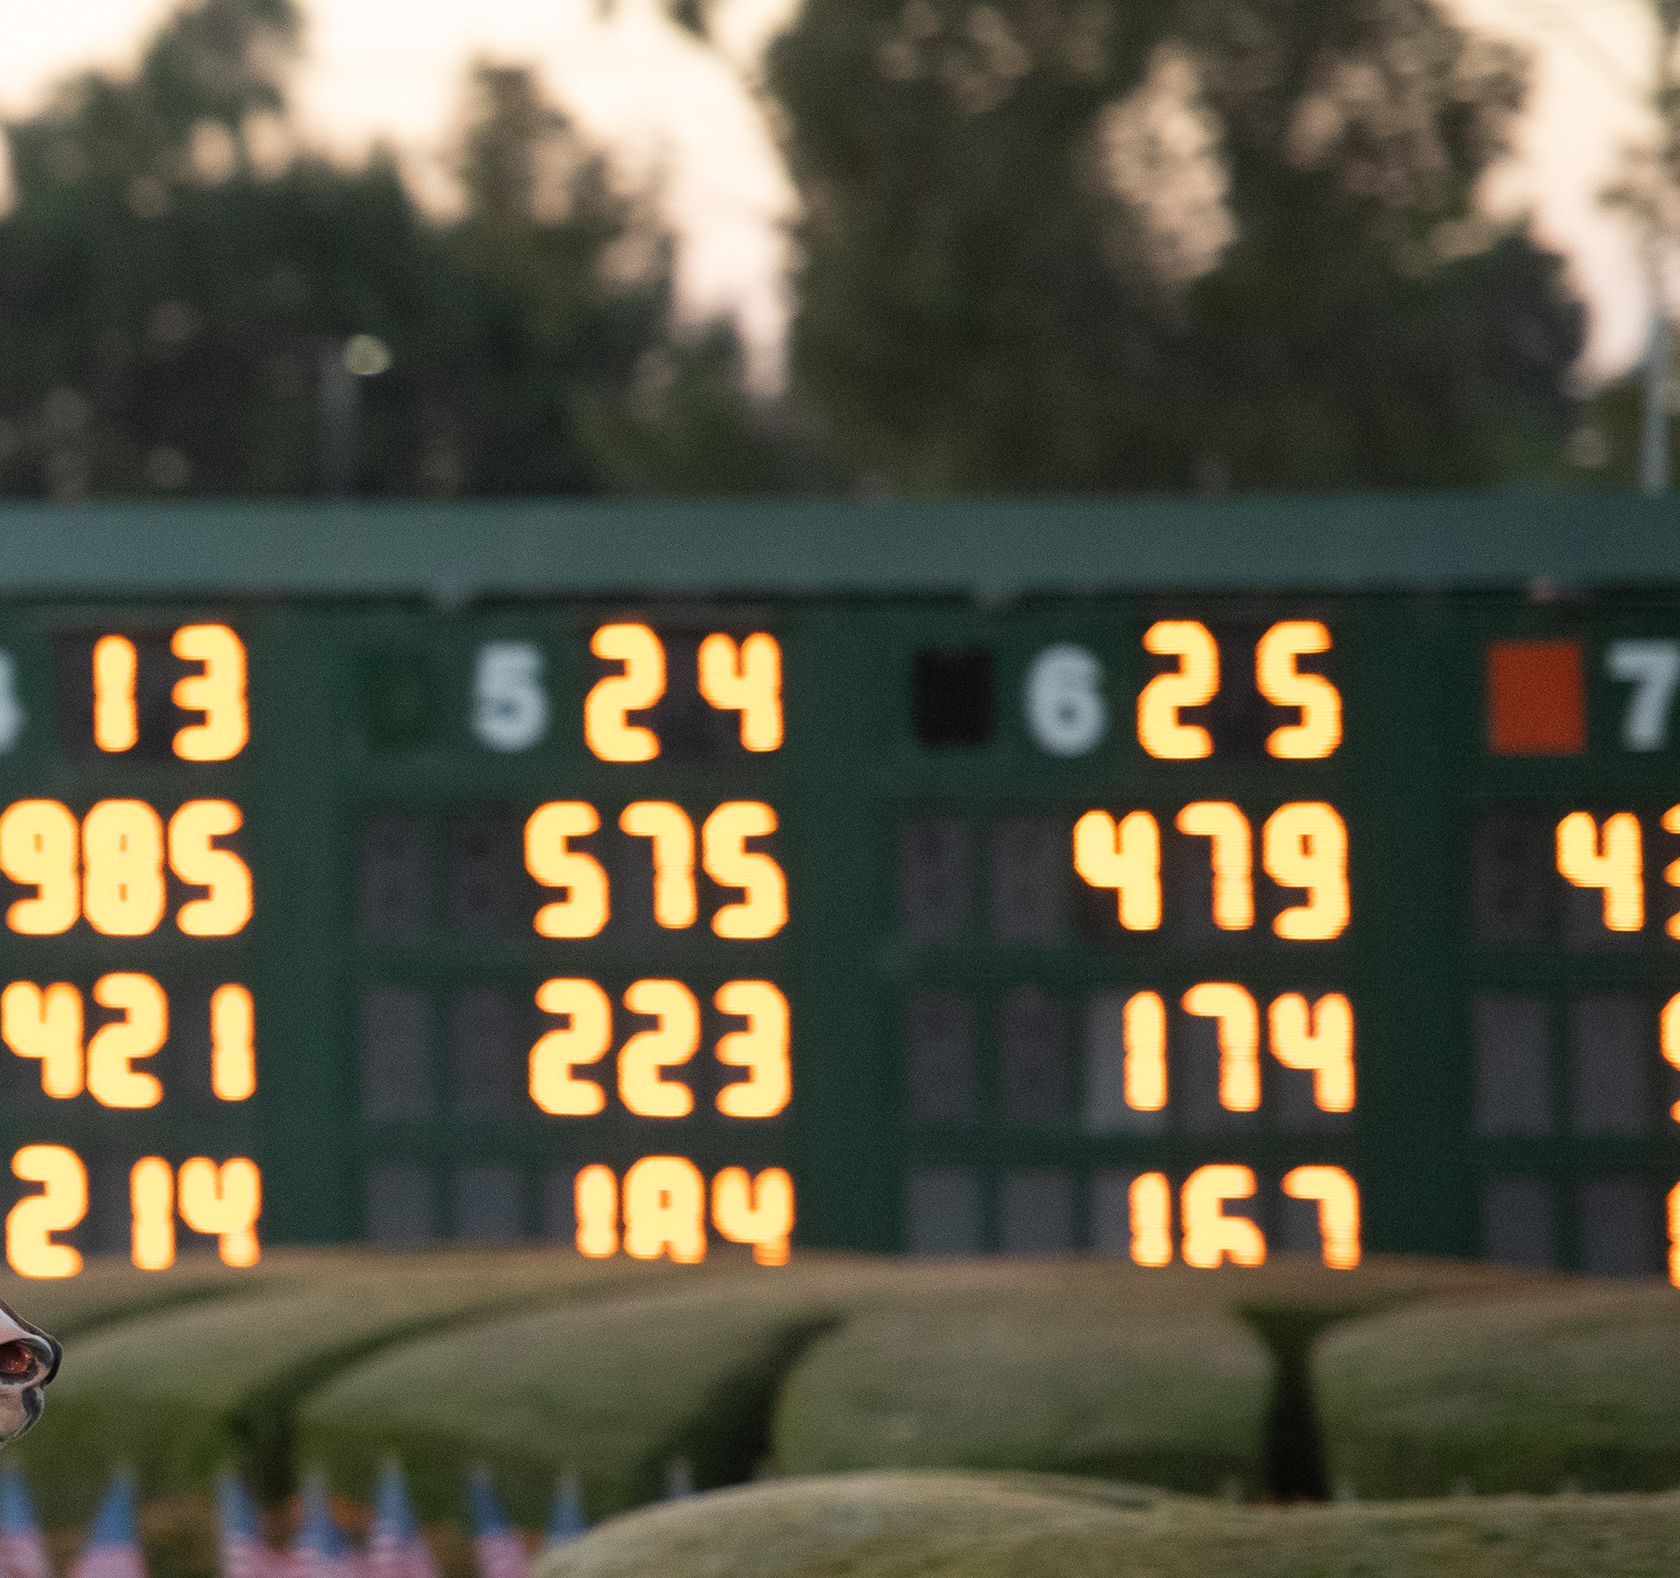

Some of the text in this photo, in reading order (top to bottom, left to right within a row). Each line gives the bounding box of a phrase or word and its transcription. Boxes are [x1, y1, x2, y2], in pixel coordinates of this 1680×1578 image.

[470, 622, 785, 763] 5 24
[1027, 619, 1343, 760] 6 25
[1606, 640, 1680, 752] 7
[523, 800, 789, 940] 575
[1072, 800, 1351, 942] 479
[1555, 800, 1680, 940] 4
[0, 971, 257, 1110] 421
[527, 976, 793, 1119] 223
[1122, 981, 1356, 1114] 174
